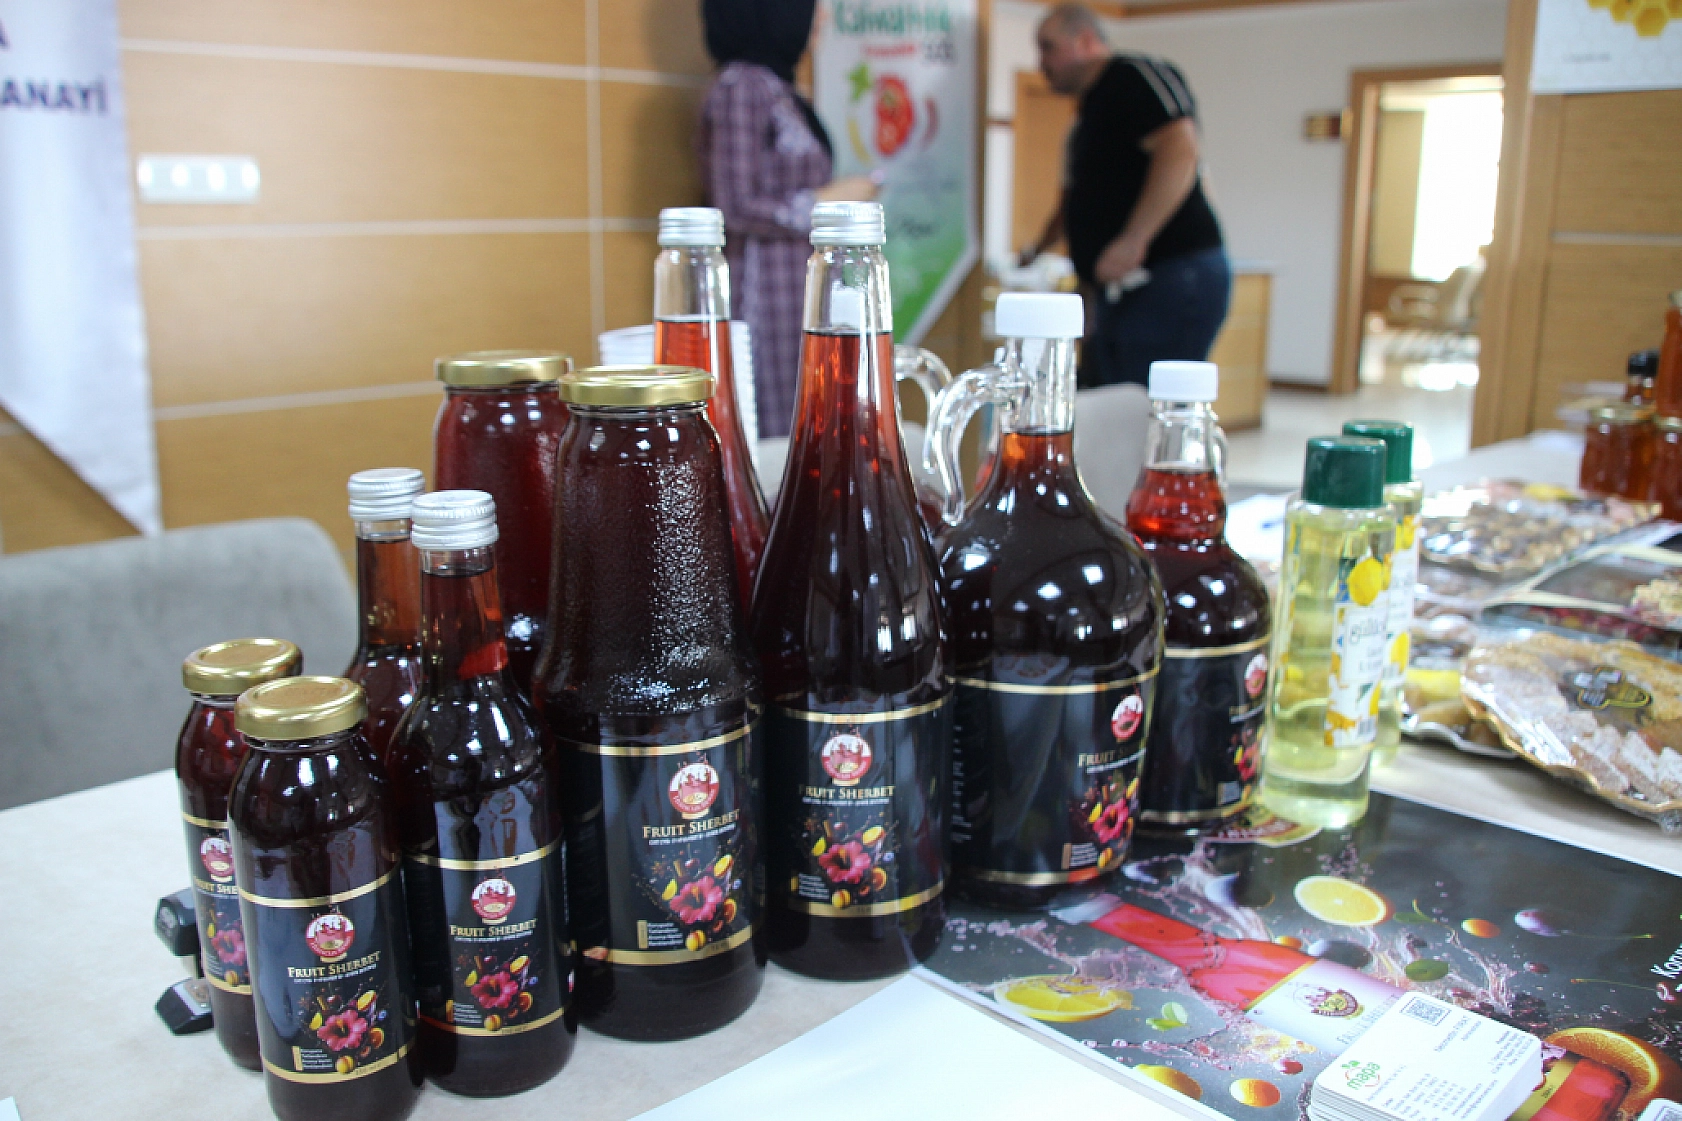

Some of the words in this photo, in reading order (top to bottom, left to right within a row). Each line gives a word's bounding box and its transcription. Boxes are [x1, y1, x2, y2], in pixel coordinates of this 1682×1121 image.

[838, 785, 896, 800] SHERBET
[642, 824, 686, 839] FRUIT
[689, 808, 740, 834] SHERBET
[450, 924, 486, 937] FRUIT
[488, 918, 538, 937] SHERBET
[287, 966, 326, 978] FRUIT
[328, 951, 381, 975] SHERBET
[1346, 1061, 1381, 1091] mapa
